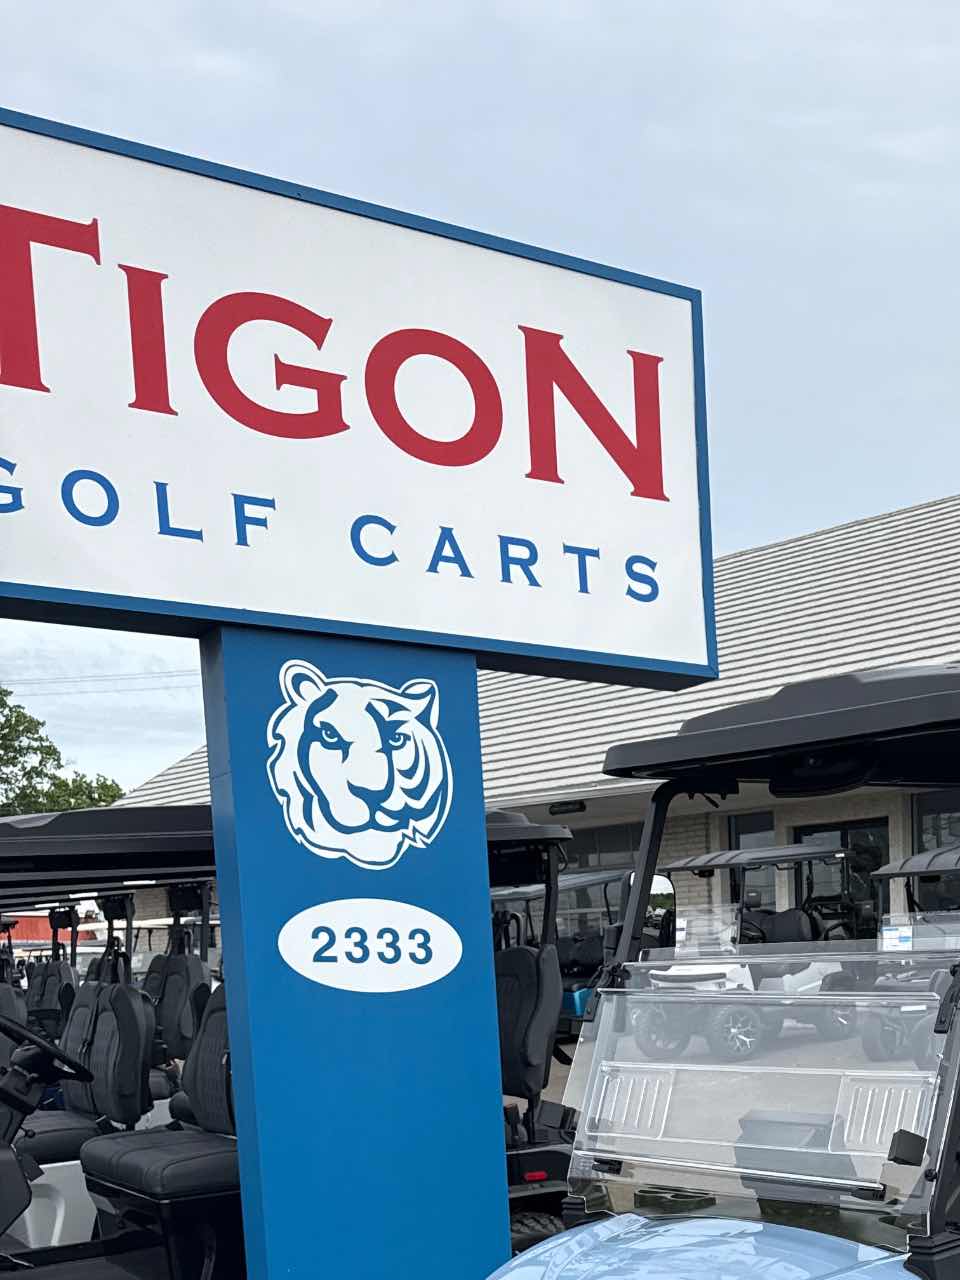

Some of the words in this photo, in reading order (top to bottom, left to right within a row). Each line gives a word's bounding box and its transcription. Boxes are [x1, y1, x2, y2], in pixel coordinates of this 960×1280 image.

[0, 205, 669, 501] TIGON
[350, 514, 660, 603] CARTS
[311, 926, 433, 965] 2333
